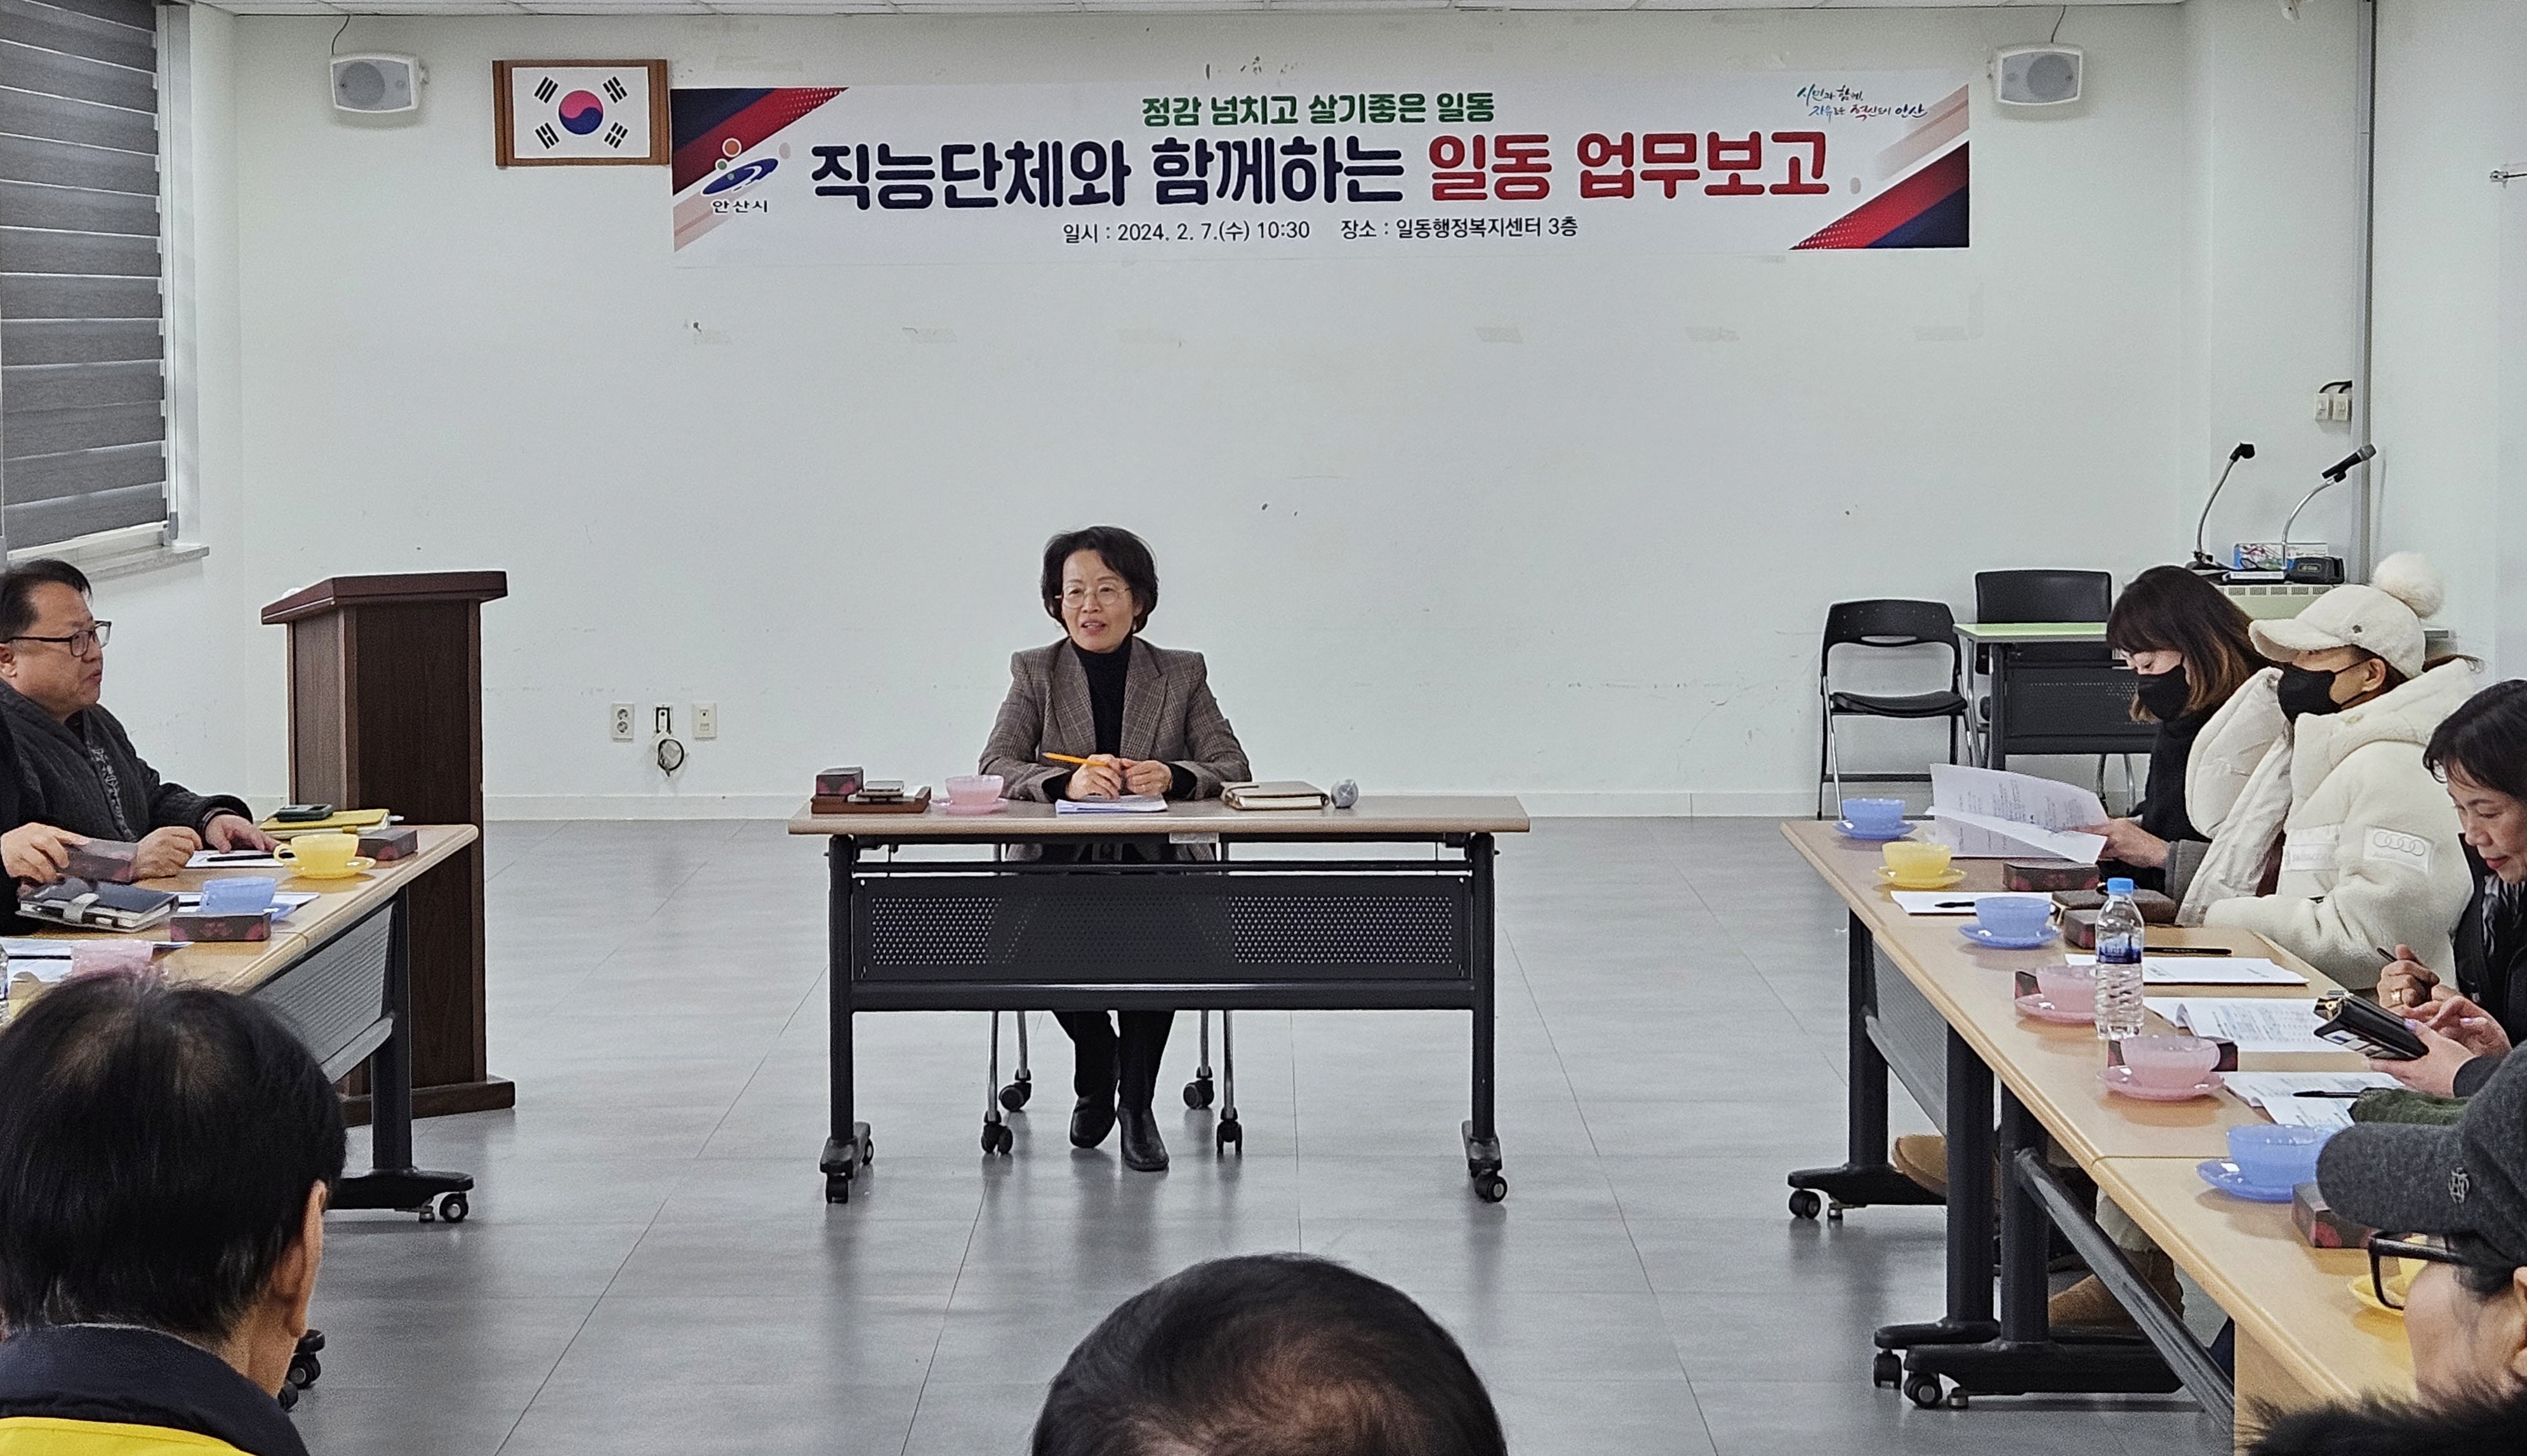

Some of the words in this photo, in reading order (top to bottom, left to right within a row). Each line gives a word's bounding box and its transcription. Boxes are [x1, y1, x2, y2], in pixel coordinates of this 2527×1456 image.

[1796, 84, 1836, 107] 시민과
[1142, 96, 1202, 128] 정감
[1210, 95, 1299, 126] 넘치고
[1308, 93, 1427, 124] 살기좋은
[1436, 92, 1496, 123] 일동
[1894, 103, 1928, 119] 안산
[811, 139, 1132, 211] 직능단체와
[1151, 135, 1405, 206] 함께하는
[1428, 134, 1553, 201] 일동
[1577, 131, 1830, 199] 업무보고
[712, 199, 769, 213] 안산시
[1063, 223, 1098, 244] 일시
[1106, 226, 1111, 240] :
[1117, 223, 1170, 242] 2024.
[1177, 223, 1194, 241] 2.
[1200, 220, 1250, 242] 7.(수)
[1257, 220, 1310, 239] 10:30
[1340, 219, 1377, 240] 장소
[1384, 222, 1390, 235] :
[1396, 216, 1542, 240] 일동행정복지센터
[1548, 216, 1579, 237] 3층
